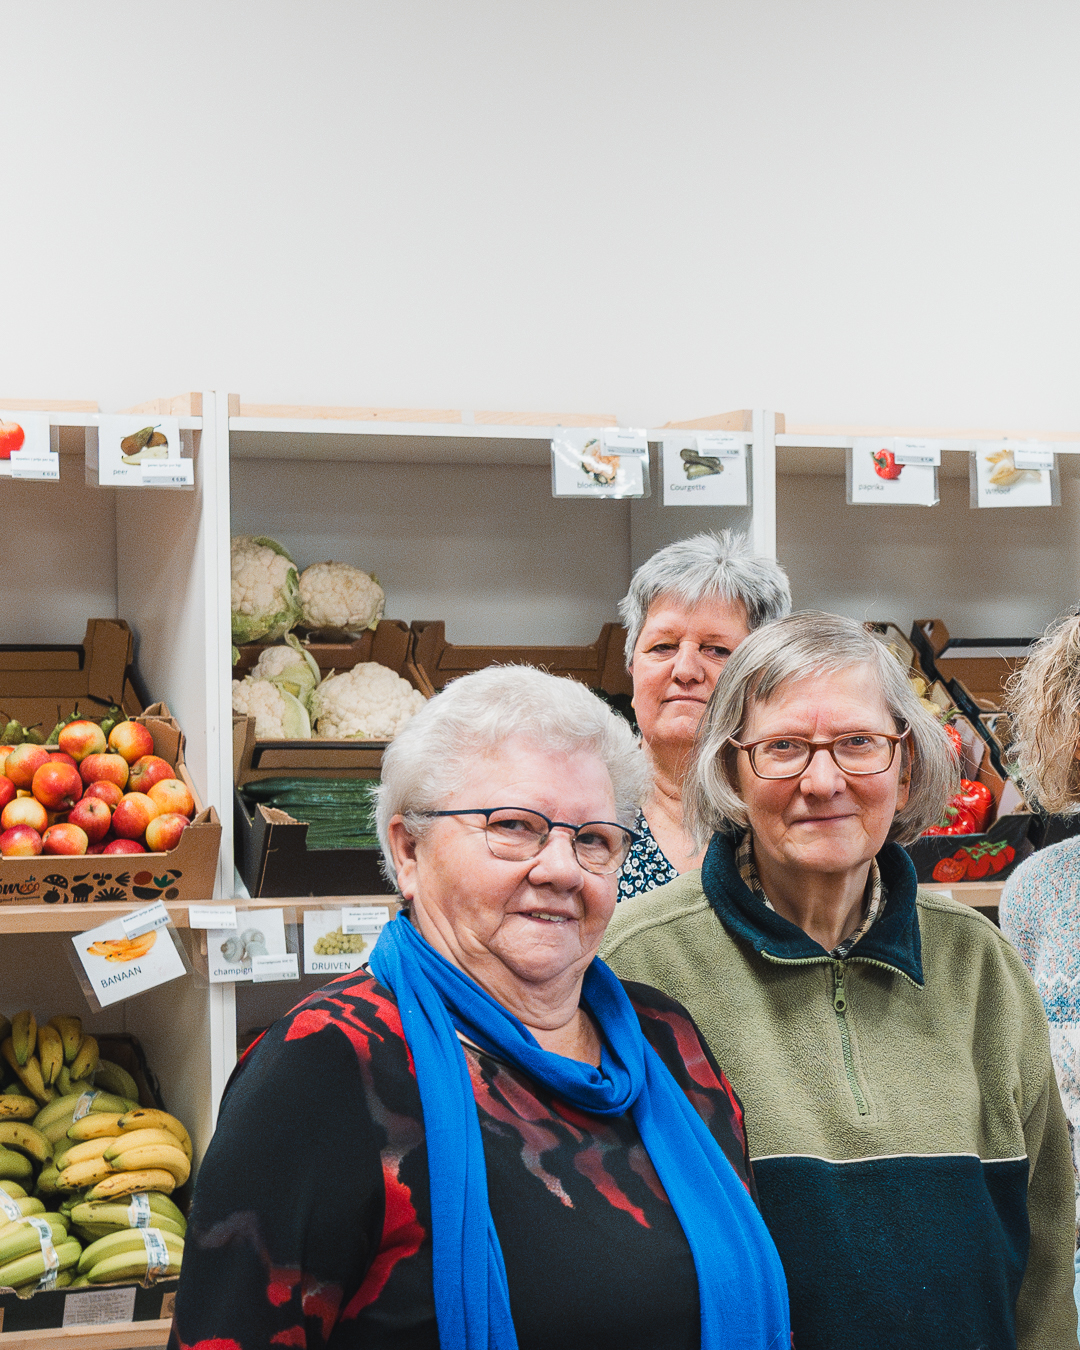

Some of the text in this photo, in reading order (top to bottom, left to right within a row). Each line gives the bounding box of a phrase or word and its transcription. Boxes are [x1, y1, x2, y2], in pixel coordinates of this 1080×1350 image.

[112, 468, 129, 476] peer
[669, 482, 706, 492] Courgette
[858, 482, 885, 492] paprika
[213, 965, 254, 977] champign
[311, 961, 351, 971] DRUIVEN
[100, 965, 142, 989] BANAAN
